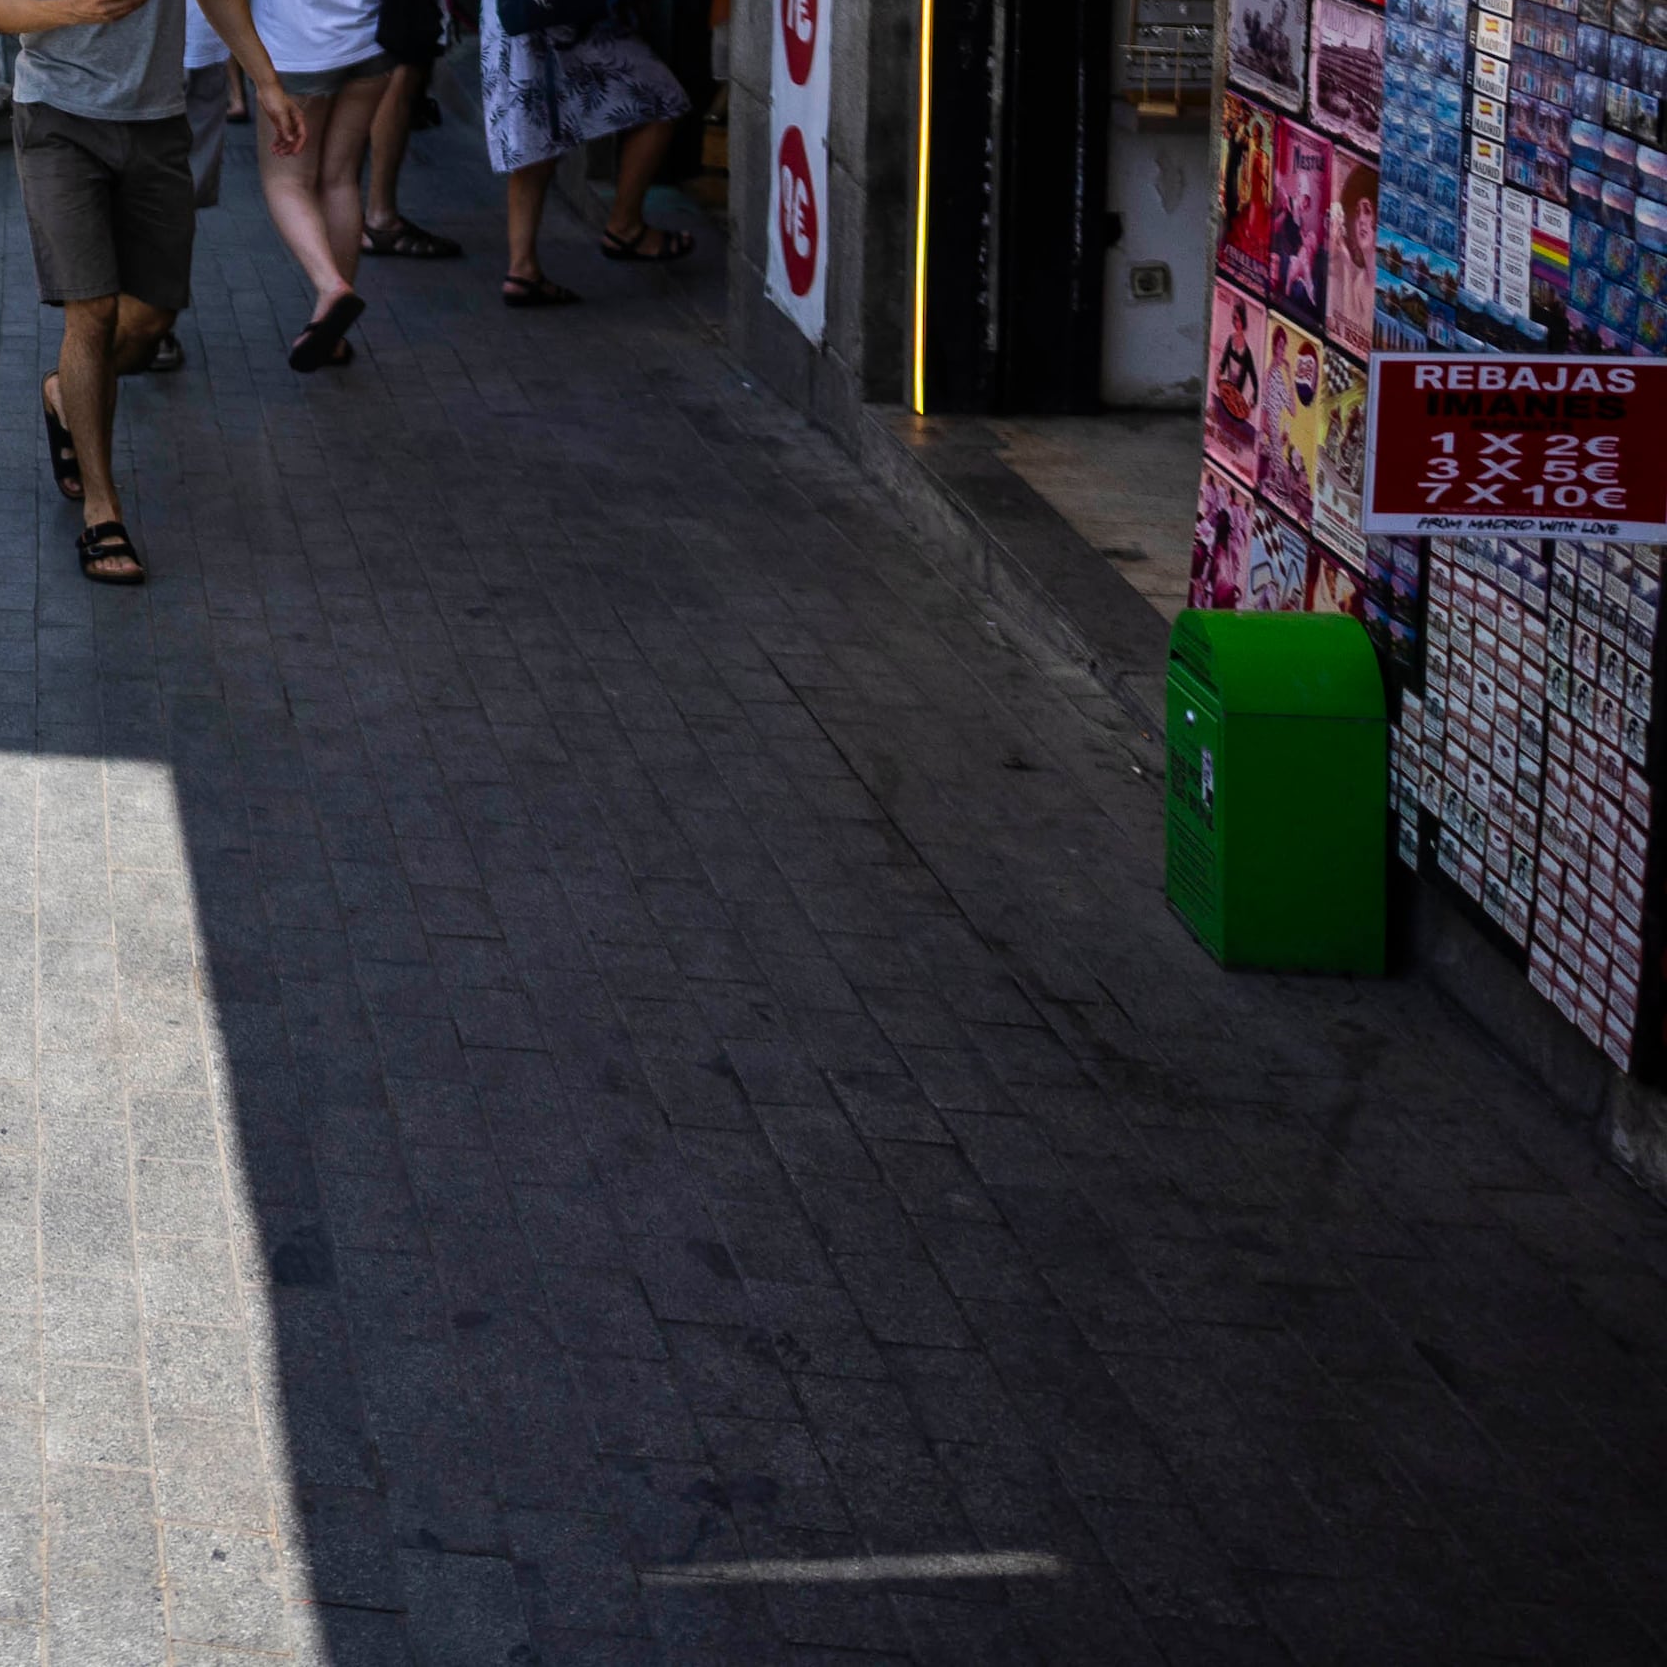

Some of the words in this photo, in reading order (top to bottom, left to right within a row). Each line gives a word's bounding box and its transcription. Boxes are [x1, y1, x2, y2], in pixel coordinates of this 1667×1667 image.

[1479, 32, 1510, 55] MADRID
[1475, 72, 1507, 95] MADRID
[1473, 114, 1503, 136] MADRID
[1472, 157, 1500, 181] MADRID
[1414, 365, 1637, 393] REBAJAS
[1426, 393, 1626, 419] IMANES
[1431, 432, 1455, 454] 1
[1477, 432, 1524, 456] X
[1543, 434, 1620, 458] 2€
[1425, 457, 1459, 479] 3
[1476, 458, 1522, 481] X
[1541, 460, 1619, 484] 5€
[1417, 482, 1452, 504] 7
[1463, 482, 1505, 505] X
[1522, 484, 1627, 509] 10€
[1417, 517, 1462, 529] FROM
[1468, 518, 1534, 531] MADRID
[1539, 521, 1576, 533] WITH
[1581, 521, 1619, 535] LOVE
